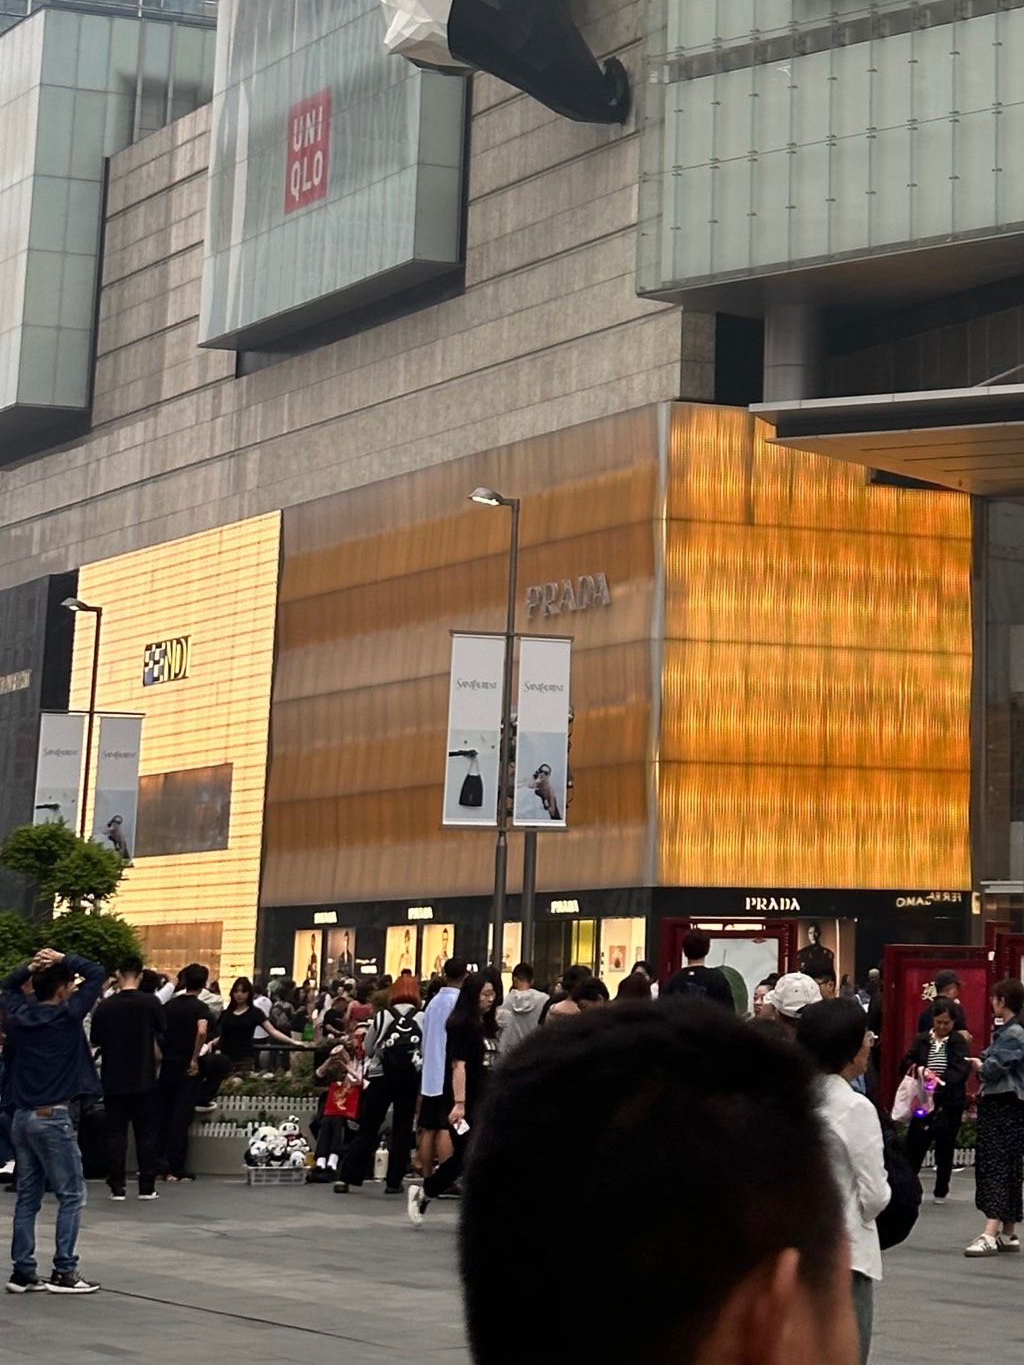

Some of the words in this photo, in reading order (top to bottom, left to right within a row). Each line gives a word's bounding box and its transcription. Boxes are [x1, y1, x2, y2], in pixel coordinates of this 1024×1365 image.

[292, 105, 324, 151] UNI
[290, 149, 323, 202] QLO
[526, 571, 612, 620] PRADA
[745, 896, 801, 911] PRADA
